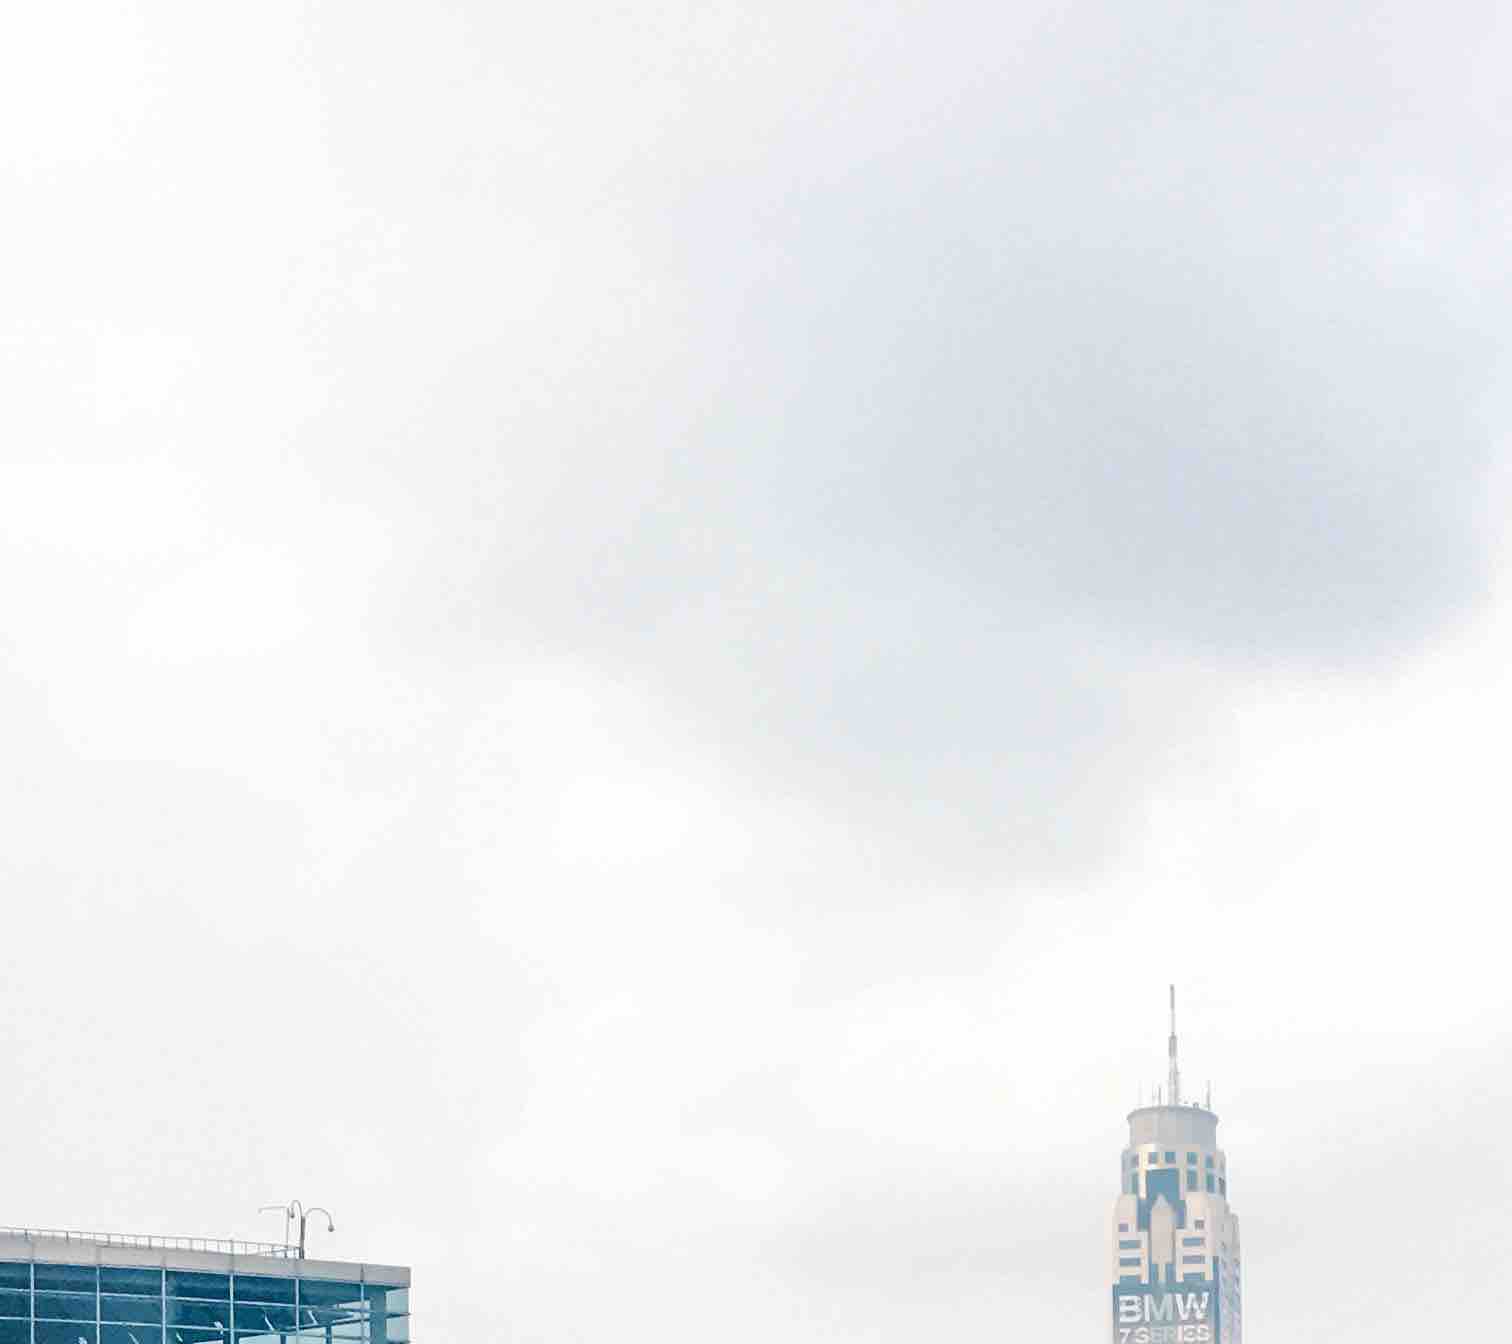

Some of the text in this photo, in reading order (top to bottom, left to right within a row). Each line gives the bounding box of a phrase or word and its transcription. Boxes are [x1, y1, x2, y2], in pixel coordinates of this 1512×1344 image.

[1119, 1293, 1209, 1322] BMW
[1119, 1325, 1209, 1344] 7 SERIES
